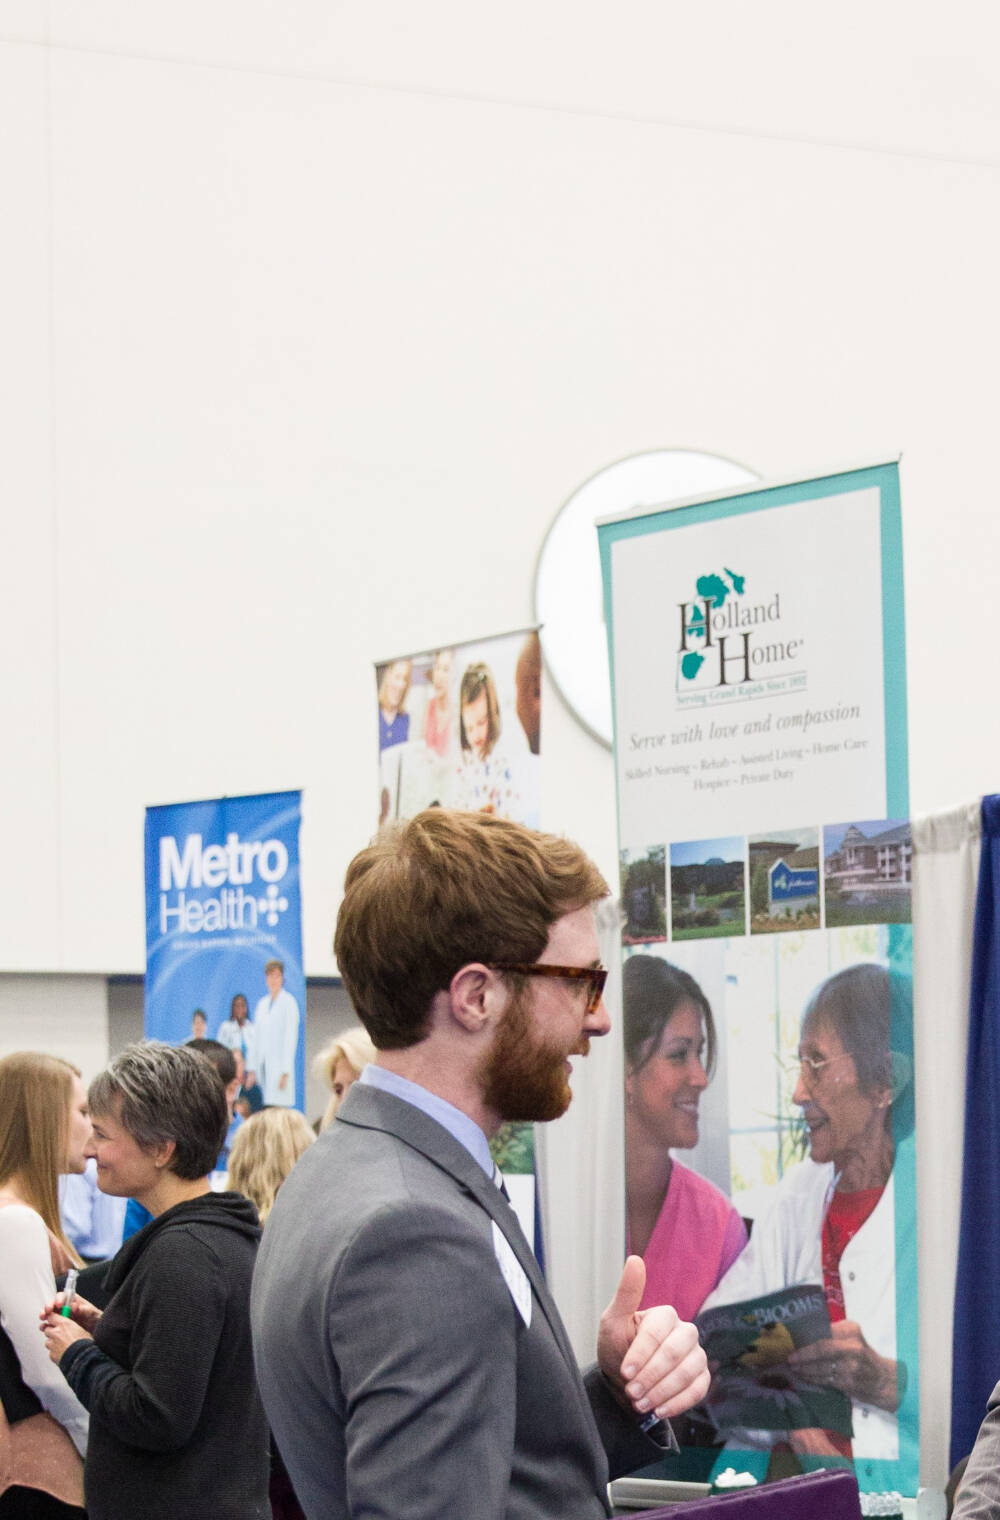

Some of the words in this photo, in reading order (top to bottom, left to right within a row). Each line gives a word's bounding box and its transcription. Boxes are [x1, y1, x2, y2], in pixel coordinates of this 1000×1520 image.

[676, 593, 782, 653] Holland
[715, 631, 799, 687] Home
[629, 731, 667, 752] Serve
[671, 724, 703, 747] with
[709, 720, 738, 741] love
[744, 713, 772, 736] and
[776, 702, 861, 734] compassion
[844, 736, 869, 750] Care
[160, 832, 290, 891] Metro
[160, 886, 259, 934] Health
